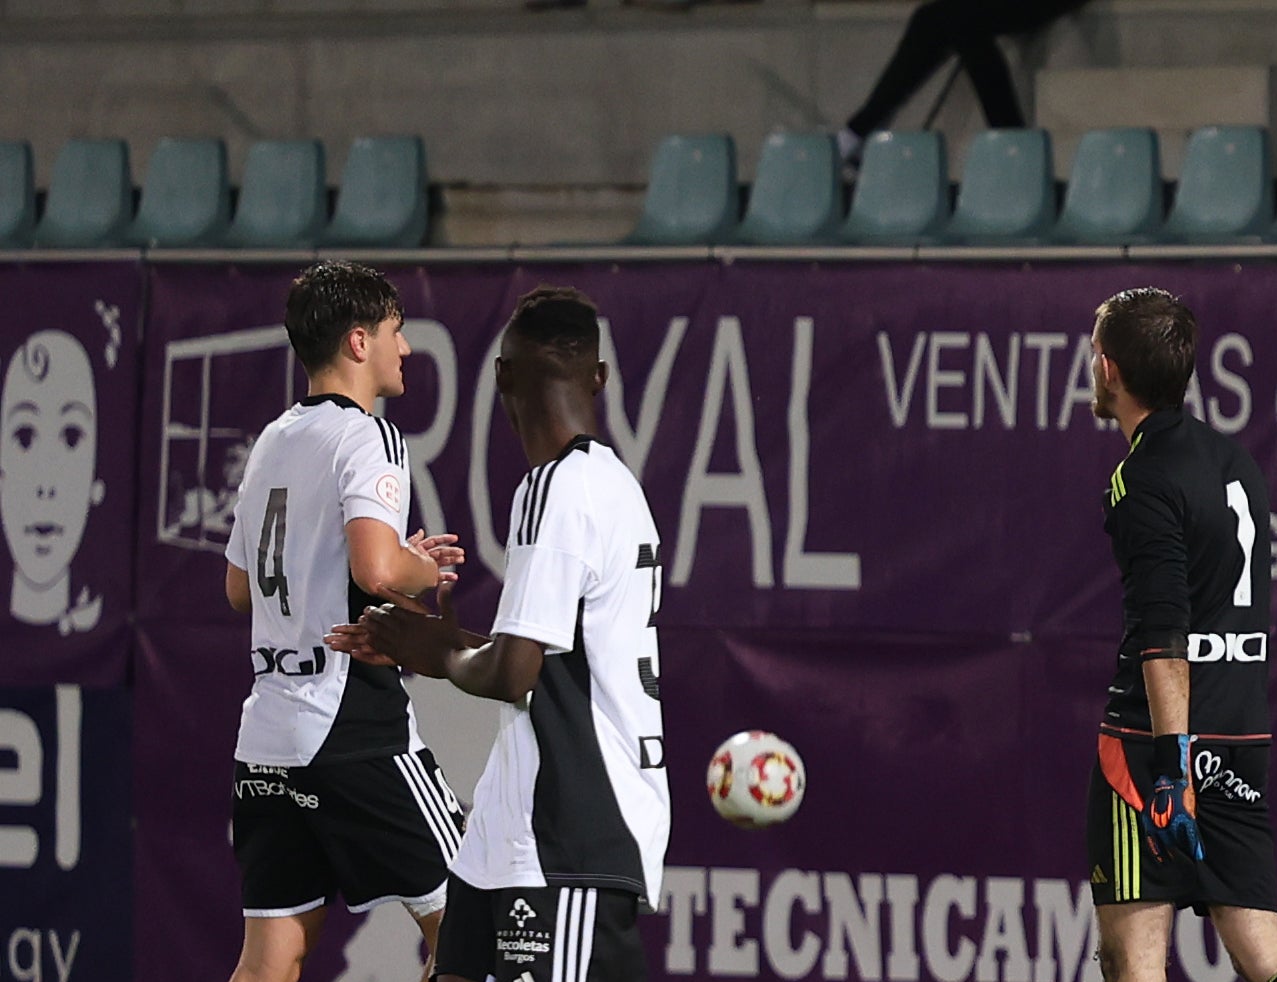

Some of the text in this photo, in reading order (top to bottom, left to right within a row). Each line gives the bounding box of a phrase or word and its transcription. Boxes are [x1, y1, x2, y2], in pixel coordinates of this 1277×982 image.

[877, 332, 1253, 434] VENTAS
[258, 487, 290, 616] 4
[1227, 480, 1257, 607] 1
